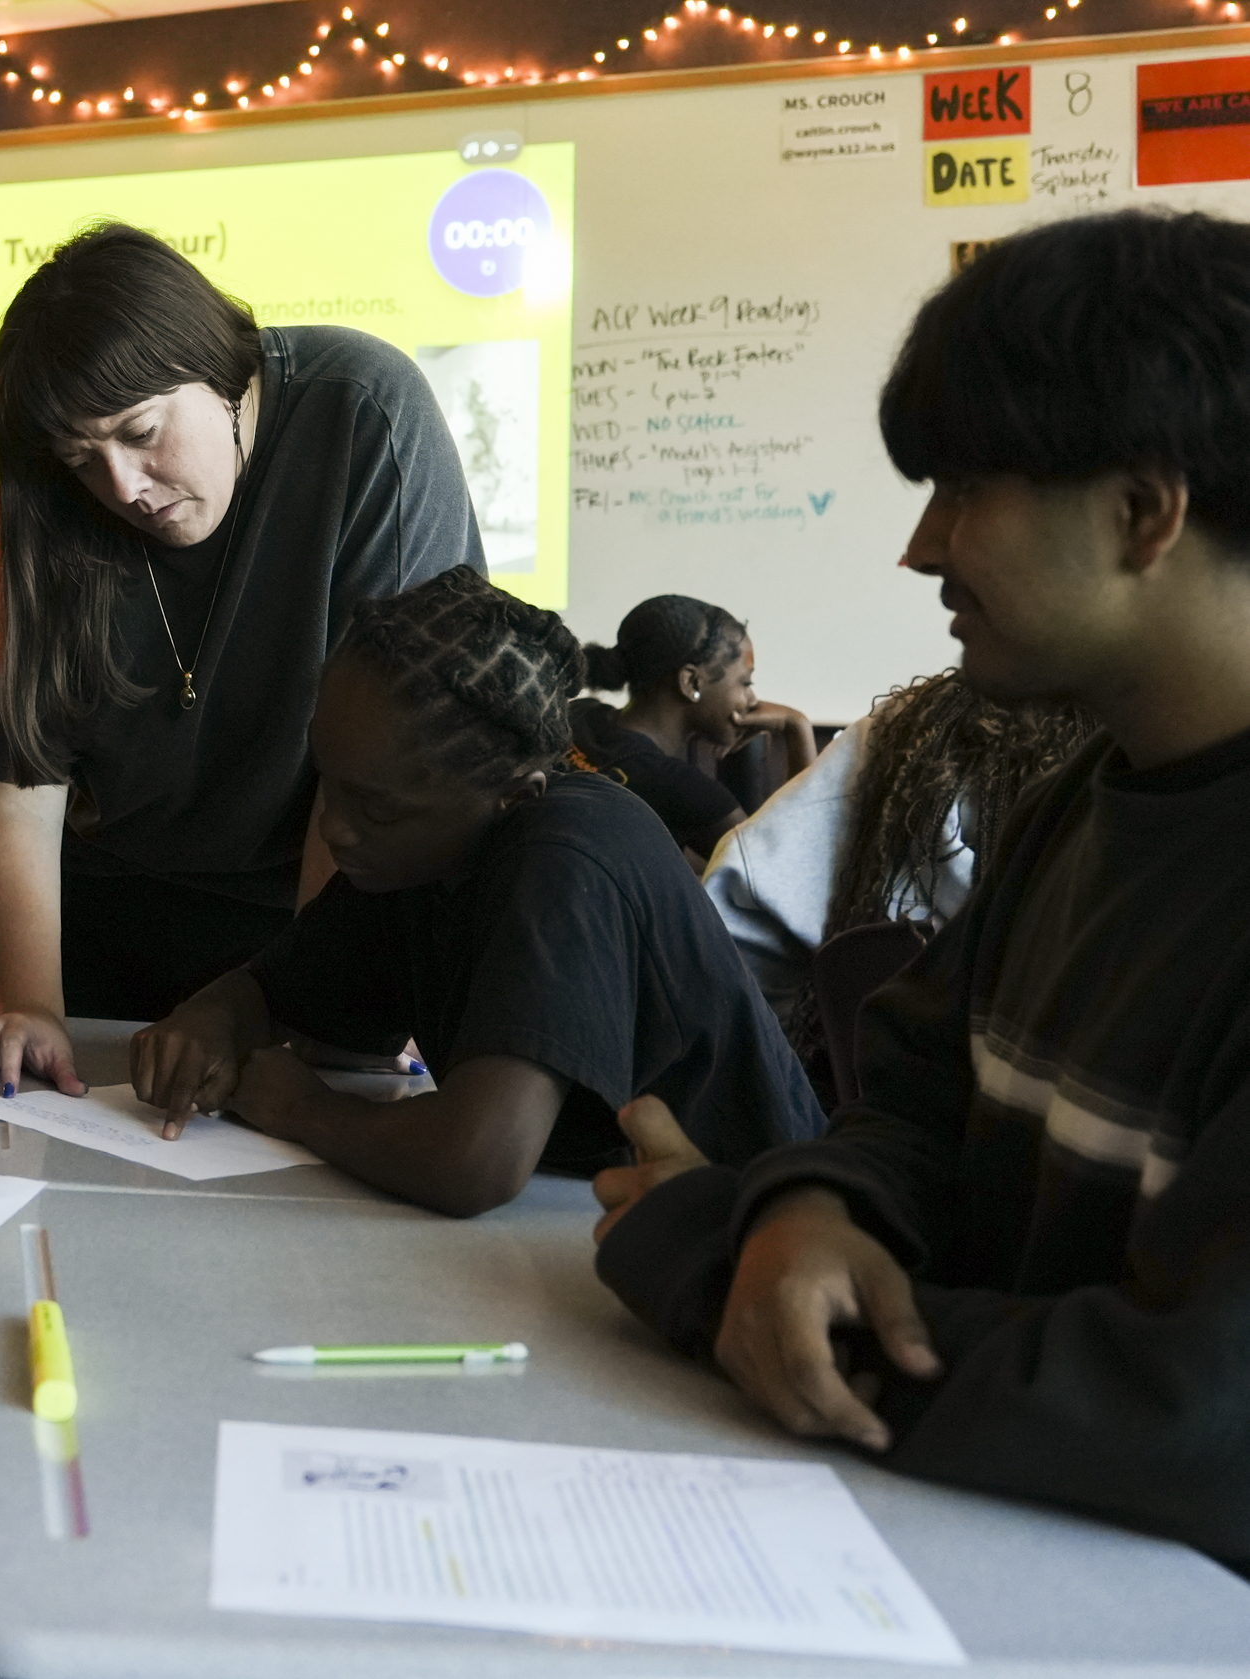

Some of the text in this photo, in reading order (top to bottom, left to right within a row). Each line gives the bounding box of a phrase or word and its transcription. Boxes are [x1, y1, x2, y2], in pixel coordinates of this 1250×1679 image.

[783, 91, 886, 111] MS. CROUCH
[930, 70, 1024, 123] WEEK
[1064, 69, 1093, 117] 8
[932, 152, 1015, 194] DATE
[444, 216, 536, 250] 00:00
[4, 236, 57, 265] Tw
[253, 298, 404, 323] nnotations.
[592, 295, 821, 331] ACP Week 9 Readings
[572, 359, 618, 380] MON
[572, 385, 618, 410] TUES
[572, 420, 621, 442] WED
[646, 416, 671, 433] NO
